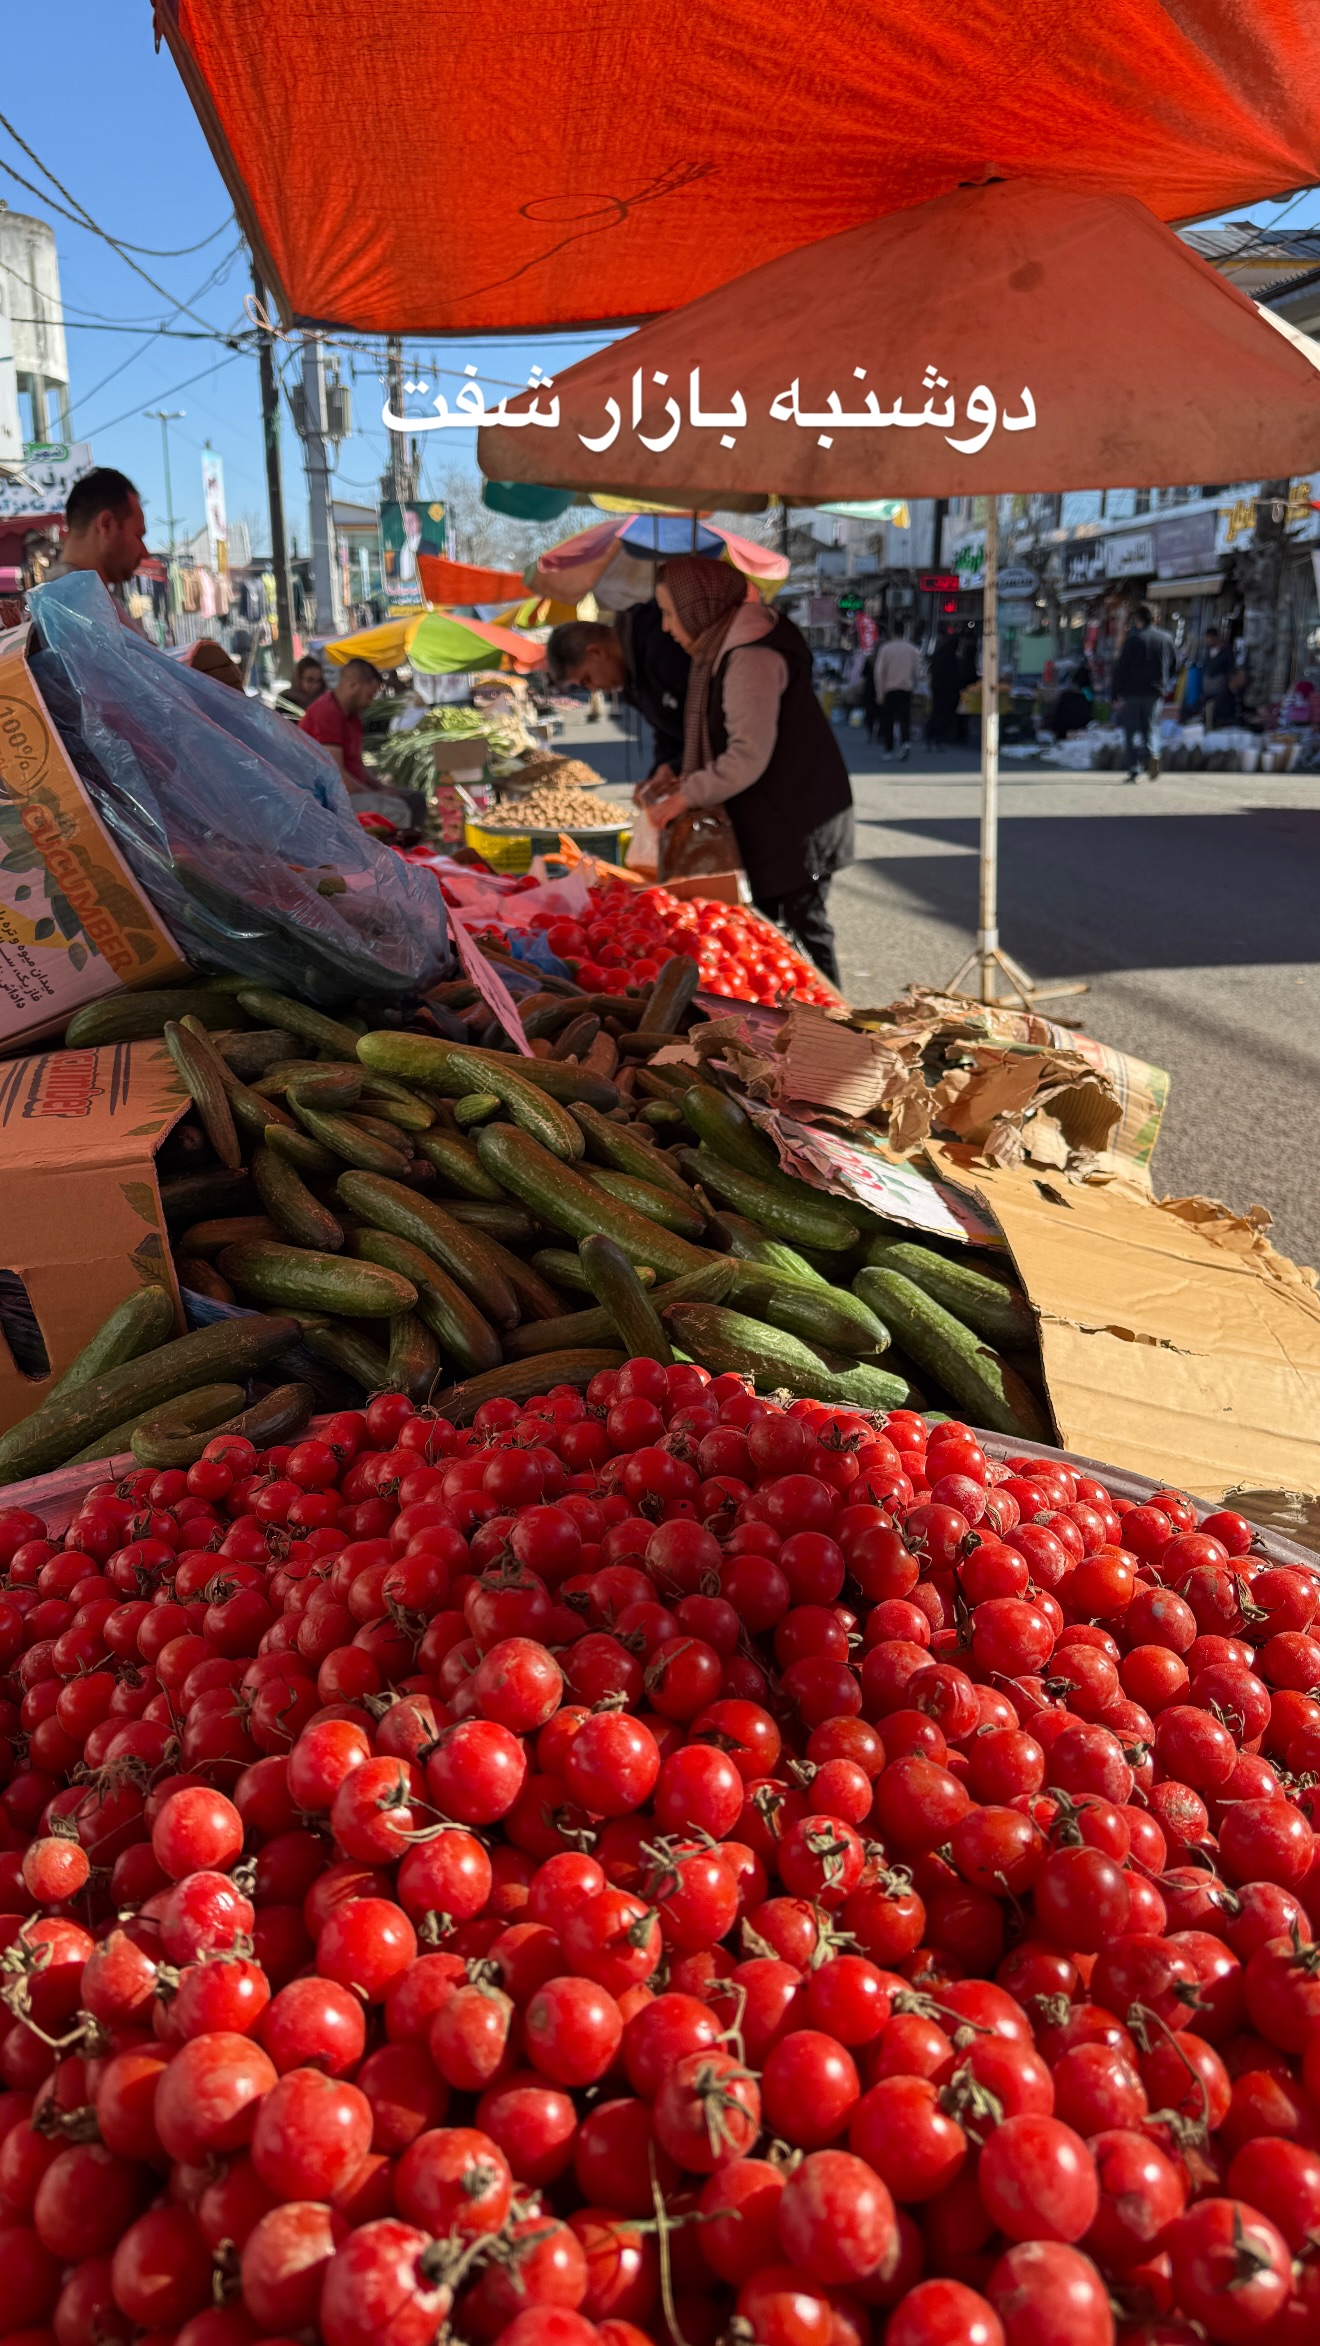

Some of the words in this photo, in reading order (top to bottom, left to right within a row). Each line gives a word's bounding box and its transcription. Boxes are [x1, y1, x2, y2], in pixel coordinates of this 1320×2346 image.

[0, 706, 38, 771] 100%
[21, 803, 136, 974] CUCUMBER
[17, 945, 36, 967] میوه
[30, 968, 55, 995] میدان
